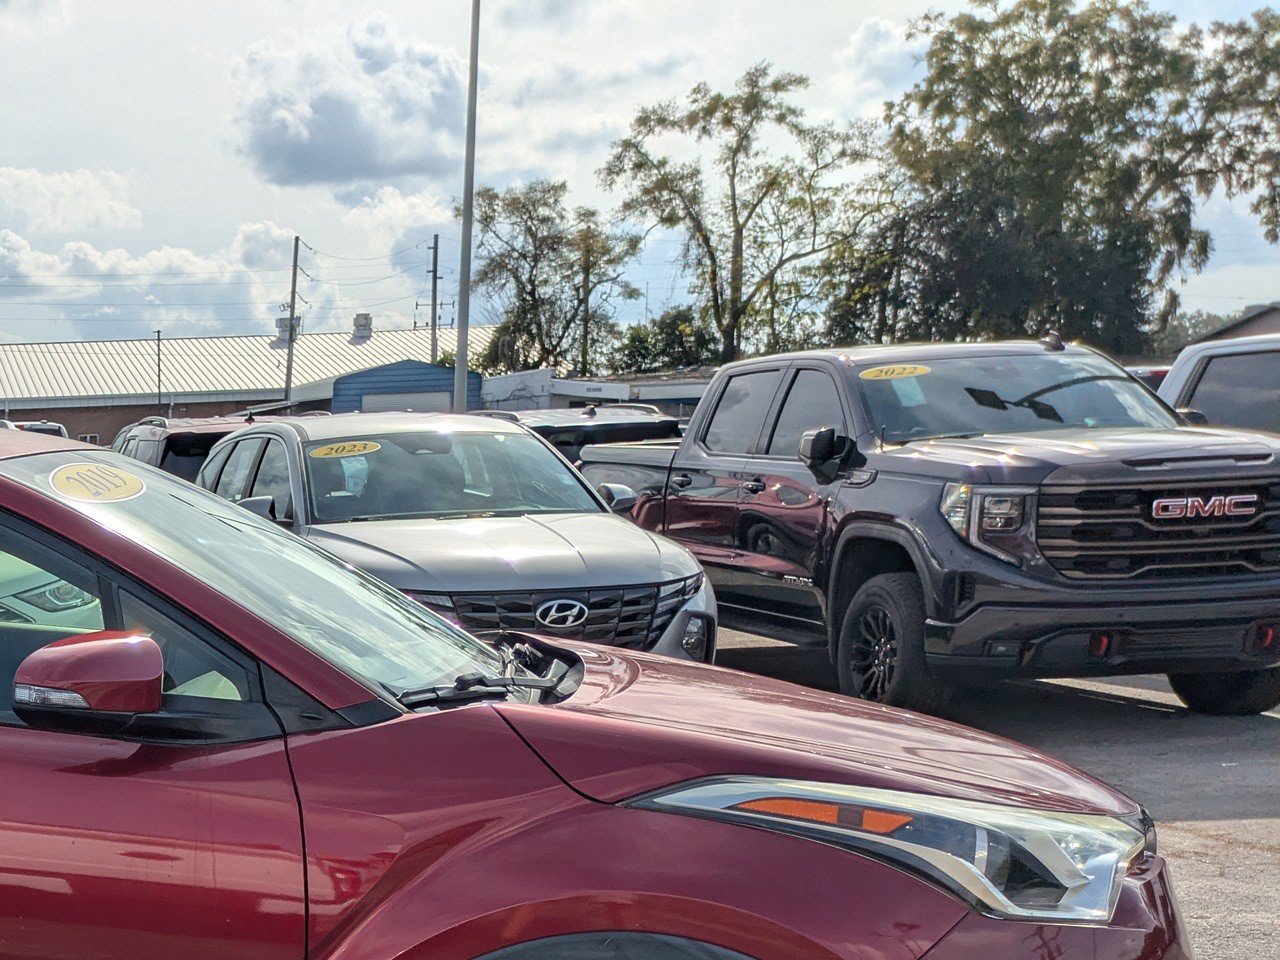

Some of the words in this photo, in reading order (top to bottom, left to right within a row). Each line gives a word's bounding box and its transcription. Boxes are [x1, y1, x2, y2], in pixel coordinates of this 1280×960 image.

[874, 367, 917, 377] 2022
[323, 443, 368, 456] 2023
[66, 466, 126, 496] 2019
[1152, 495, 1258, 518] GMC
